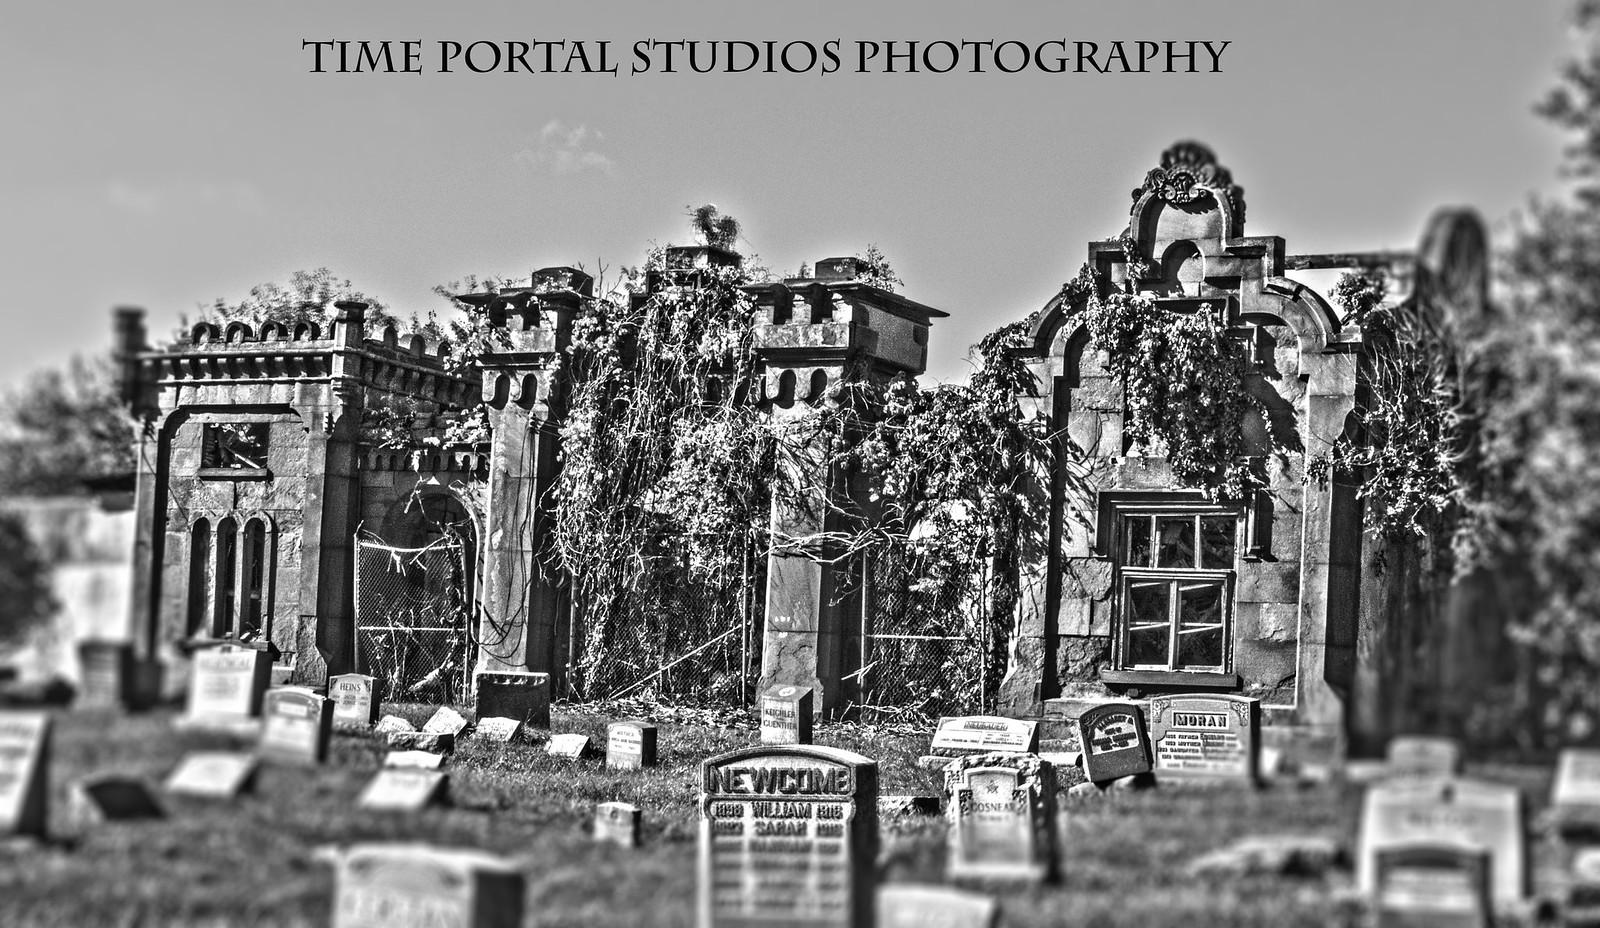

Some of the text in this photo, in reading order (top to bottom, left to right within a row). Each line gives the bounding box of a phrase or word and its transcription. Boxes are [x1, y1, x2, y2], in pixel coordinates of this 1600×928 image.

[340, 682, 361, 691] HEINS
[1174, 714, 1227, 727] MORAN
[709, 765, 850, 795] NEWCOMB
[751, 801, 812, 819] WILLIAM
